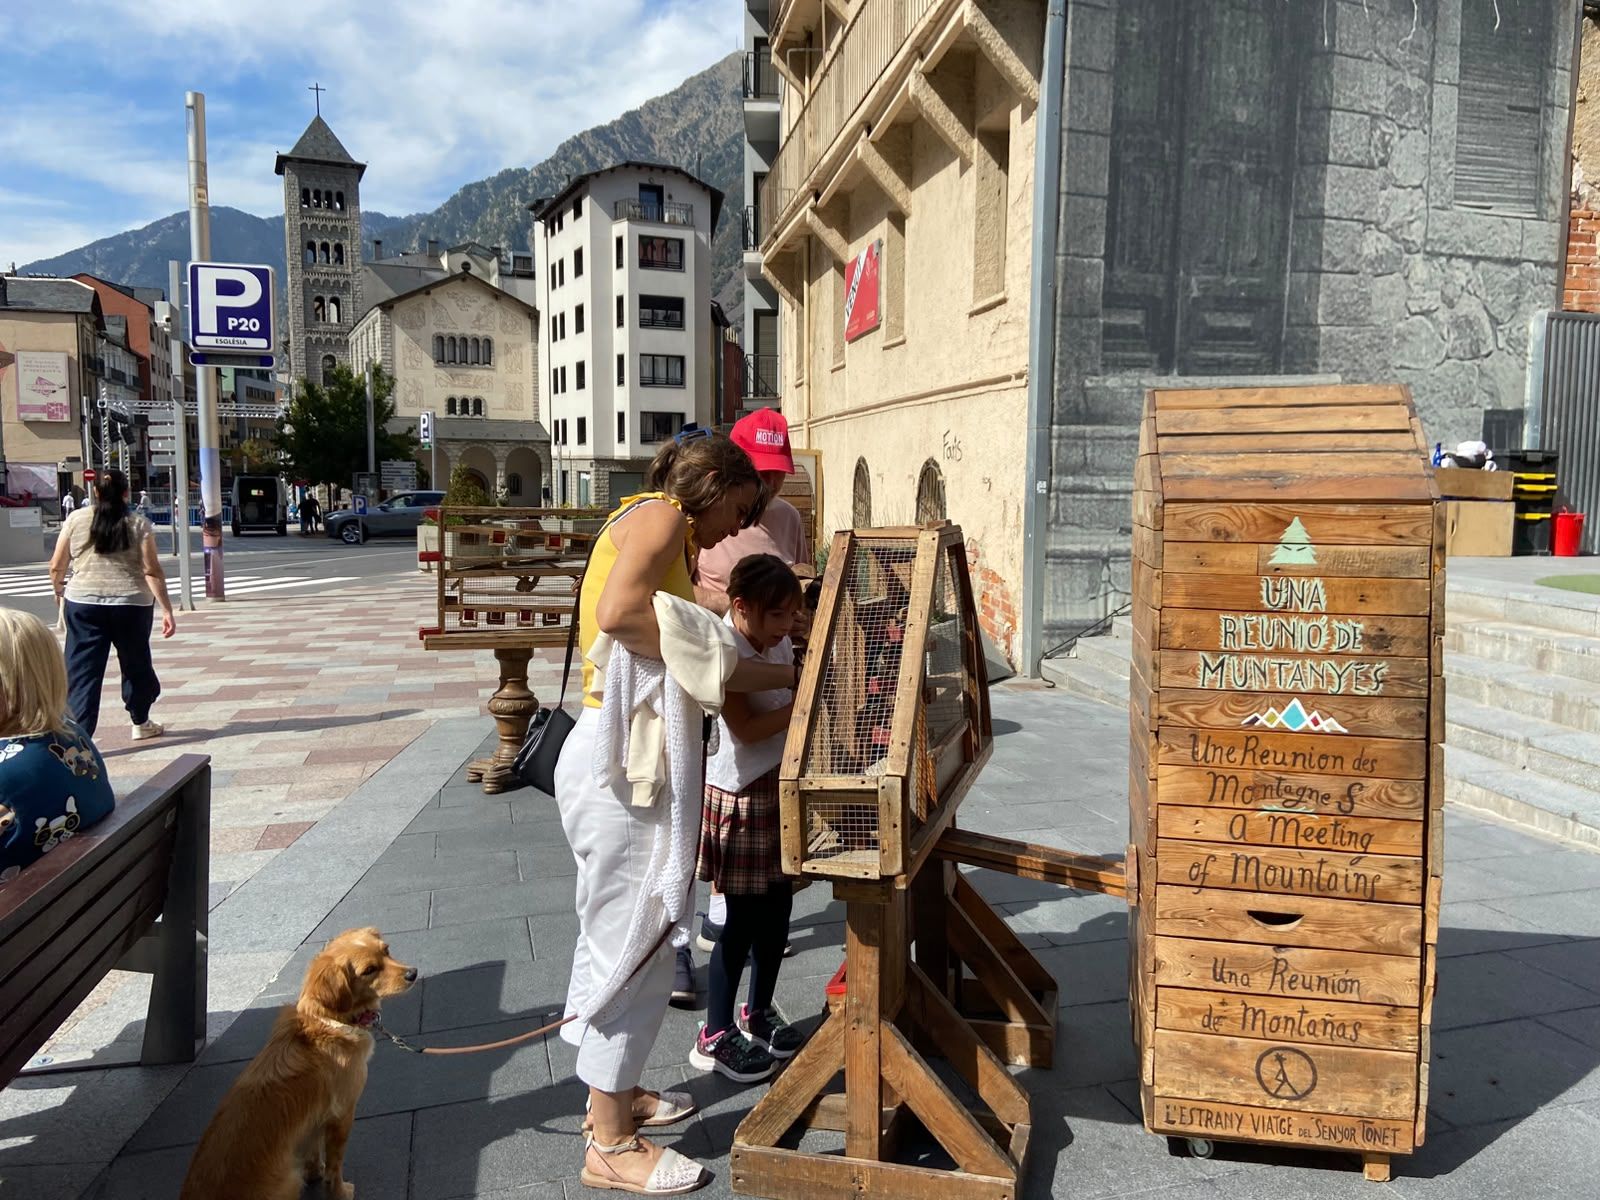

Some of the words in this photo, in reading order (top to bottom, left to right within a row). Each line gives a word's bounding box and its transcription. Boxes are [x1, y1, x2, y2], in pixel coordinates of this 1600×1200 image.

[198, 267, 262, 333] P
[216, 338, 248, 346] ESGLÉSIA
[228, 317, 260, 332] P20
[756, 431, 784, 444] MOTION
[356, 499, 364, 513] P
[1262, 577, 1326, 611] UNA
[1334, 623, 1363, 652] DE
[1200, 655, 1387, 694] MUNTANYES
[1190, 734, 1236, 768] Une
[1241, 736, 1344, 773] Reunion
[1352, 748, 1378, 773] des
[1268, 816, 1374, 863] Meeting
[1189, 855, 1216, 894] of
[1212, 957, 1251, 988] Una
[1269, 957, 1361, 996] Reunión
[1201, 1004, 1223, 1033] de
[1241, 1001, 1362, 1041] Montañas
[1164, 1104, 1243, 1132] L'ESTRANY
[1250, 1113, 1293, 1136] VIATGE
[1298, 1127, 1312, 1138] DEL
[1358, 1120, 1401, 1147] TONET
